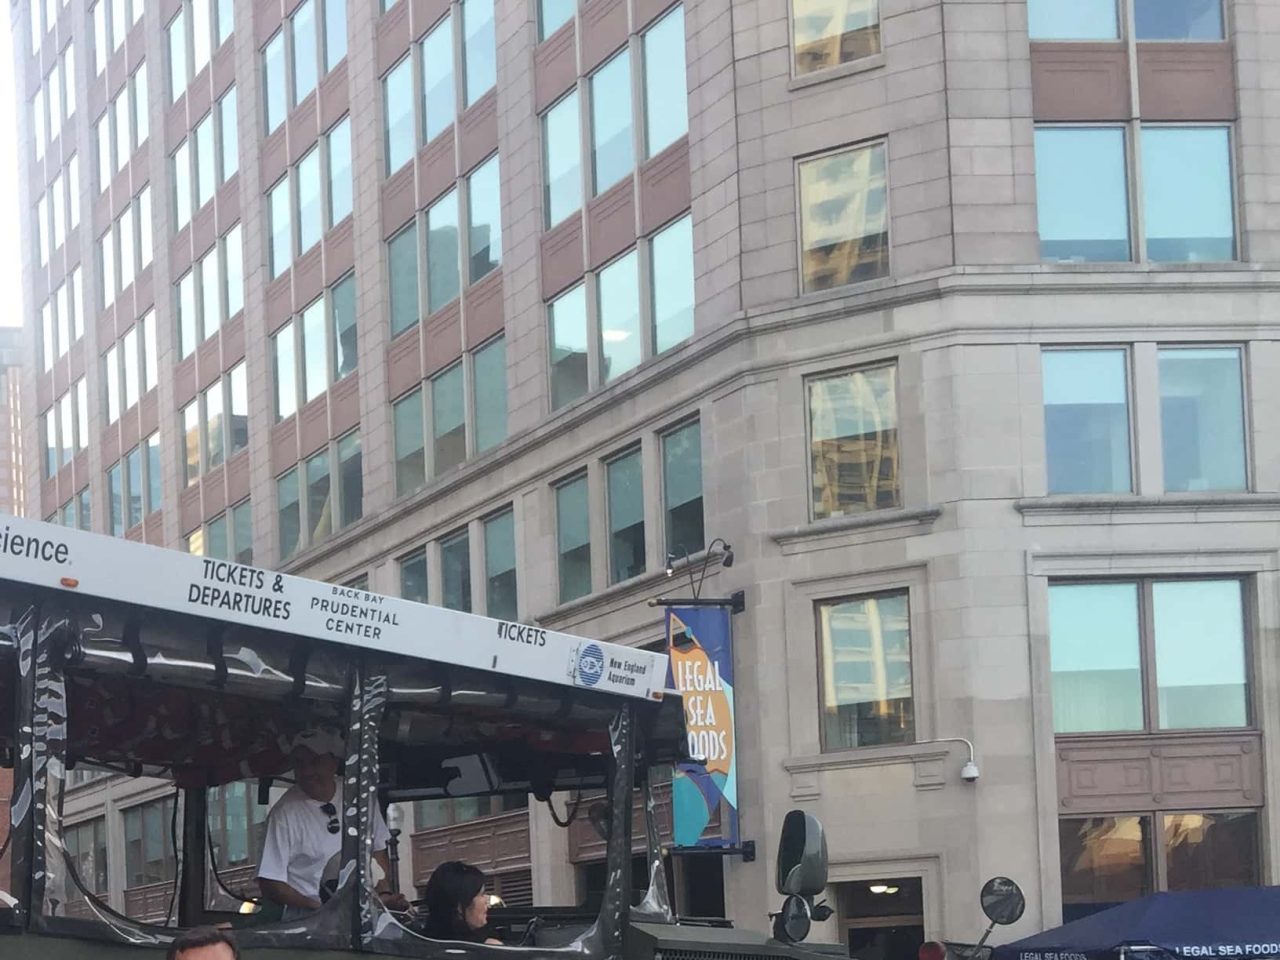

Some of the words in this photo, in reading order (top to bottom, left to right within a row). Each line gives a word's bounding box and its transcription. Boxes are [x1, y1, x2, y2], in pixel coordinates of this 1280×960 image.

[203, 559, 265, 590] TICKETS
[272, 574, 284, 593] &
[188, 583, 291, 620] DEPARTURES
[332, 587, 360, 601] BACK
[364, 593, 385, 605] BAY
[310, 597, 399, 626] PRUDENTIAL
[325, 618, 382, 640] CENTER
[497, 621, 547, 647] TICKETS
[607, 671, 636, 686] Aquarium
[609, 658, 622, 669] New
[624, 660, 647, 675] England
[678, 660, 723, 691] LEGAL
[688, 695, 716, 726] SEA
[687, 730, 727, 760] OODS
[1218, 944, 1243, 956] SEA
[1245, 943, 1280, 955] FOOD
